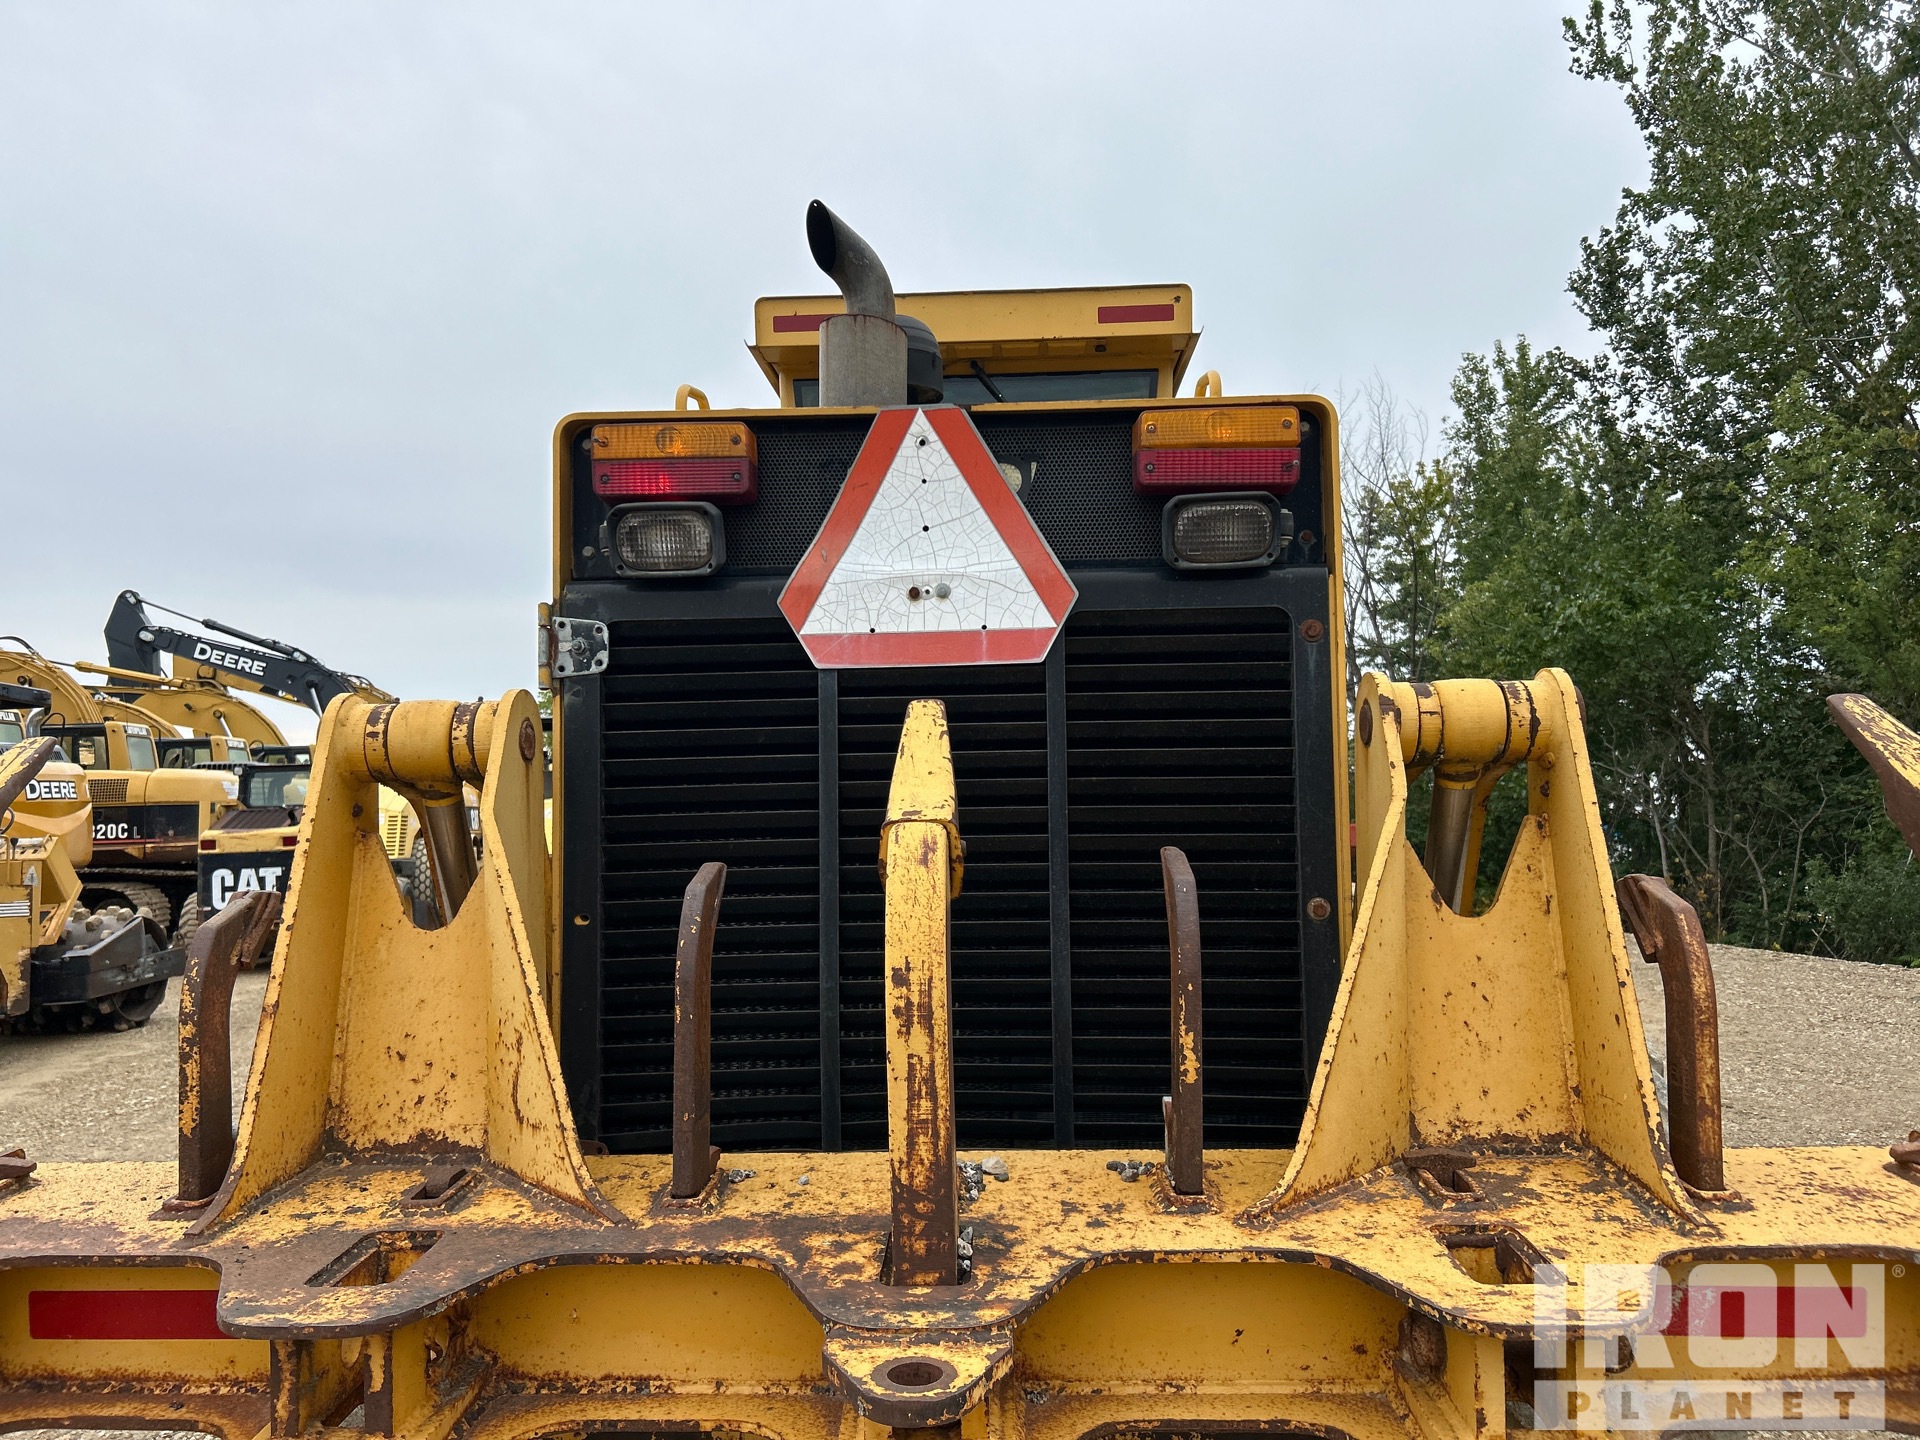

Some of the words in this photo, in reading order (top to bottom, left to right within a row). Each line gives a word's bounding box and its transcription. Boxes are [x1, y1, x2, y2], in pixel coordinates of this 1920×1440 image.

[193, 642, 267, 677] DEERE
[25, 779, 77, 800] DEERE
[133, 826, 141, 839] L
[212, 866, 282, 910] CAT
